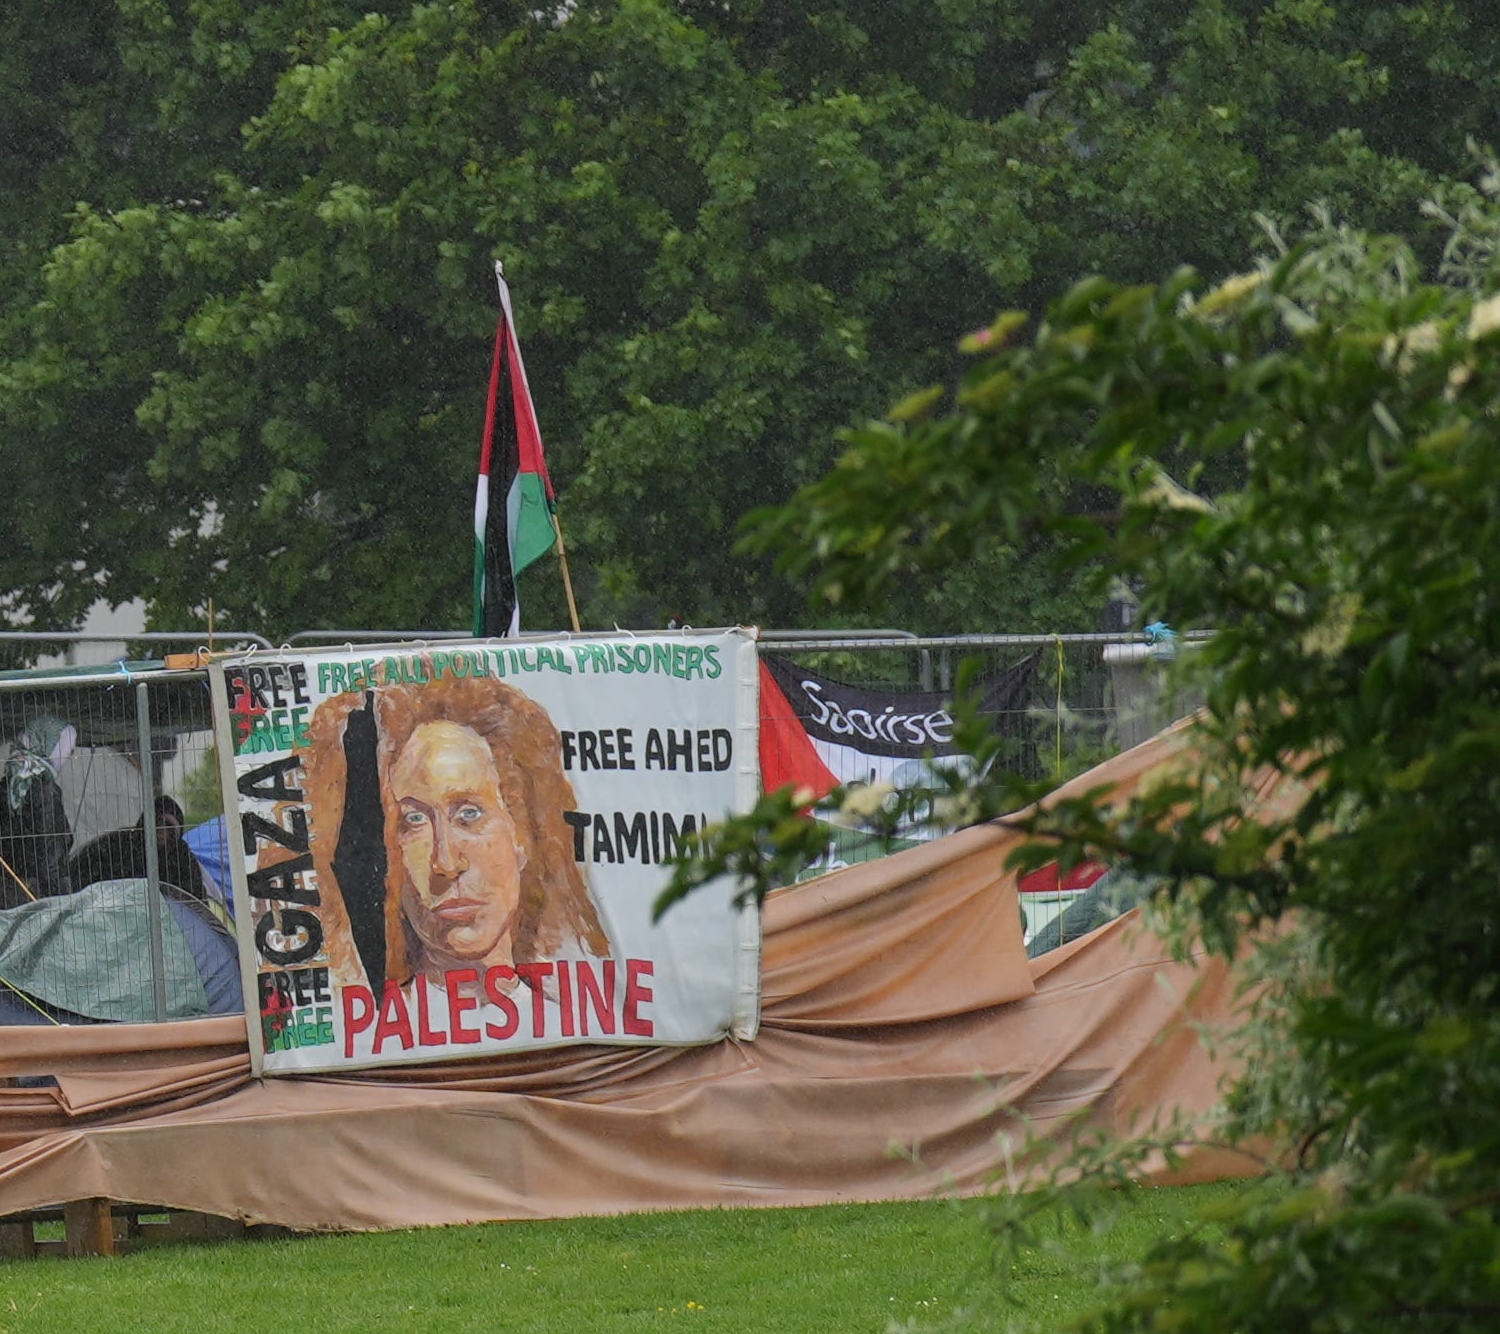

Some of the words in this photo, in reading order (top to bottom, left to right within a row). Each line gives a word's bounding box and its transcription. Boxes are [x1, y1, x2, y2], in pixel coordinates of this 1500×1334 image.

[225, 664, 311, 710] FREE
[318, 657, 377, 694] FREE
[384, 654, 428, 685] ALL
[435, 642, 571, 680] POLITICAL
[576, 642, 722, 680] PRISONERS
[230, 707, 313, 757] FREE
[801, 680, 954, 745] Saoirse
[563, 727, 635, 771] FREE
[644, 728, 733, 772] AHED
[237, 754, 322, 966] GAZA
[258, 967, 332, 1016] FREE
[342, 958, 654, 1058] PALESTINE
[263, 1006, 335, 1054] FREE
